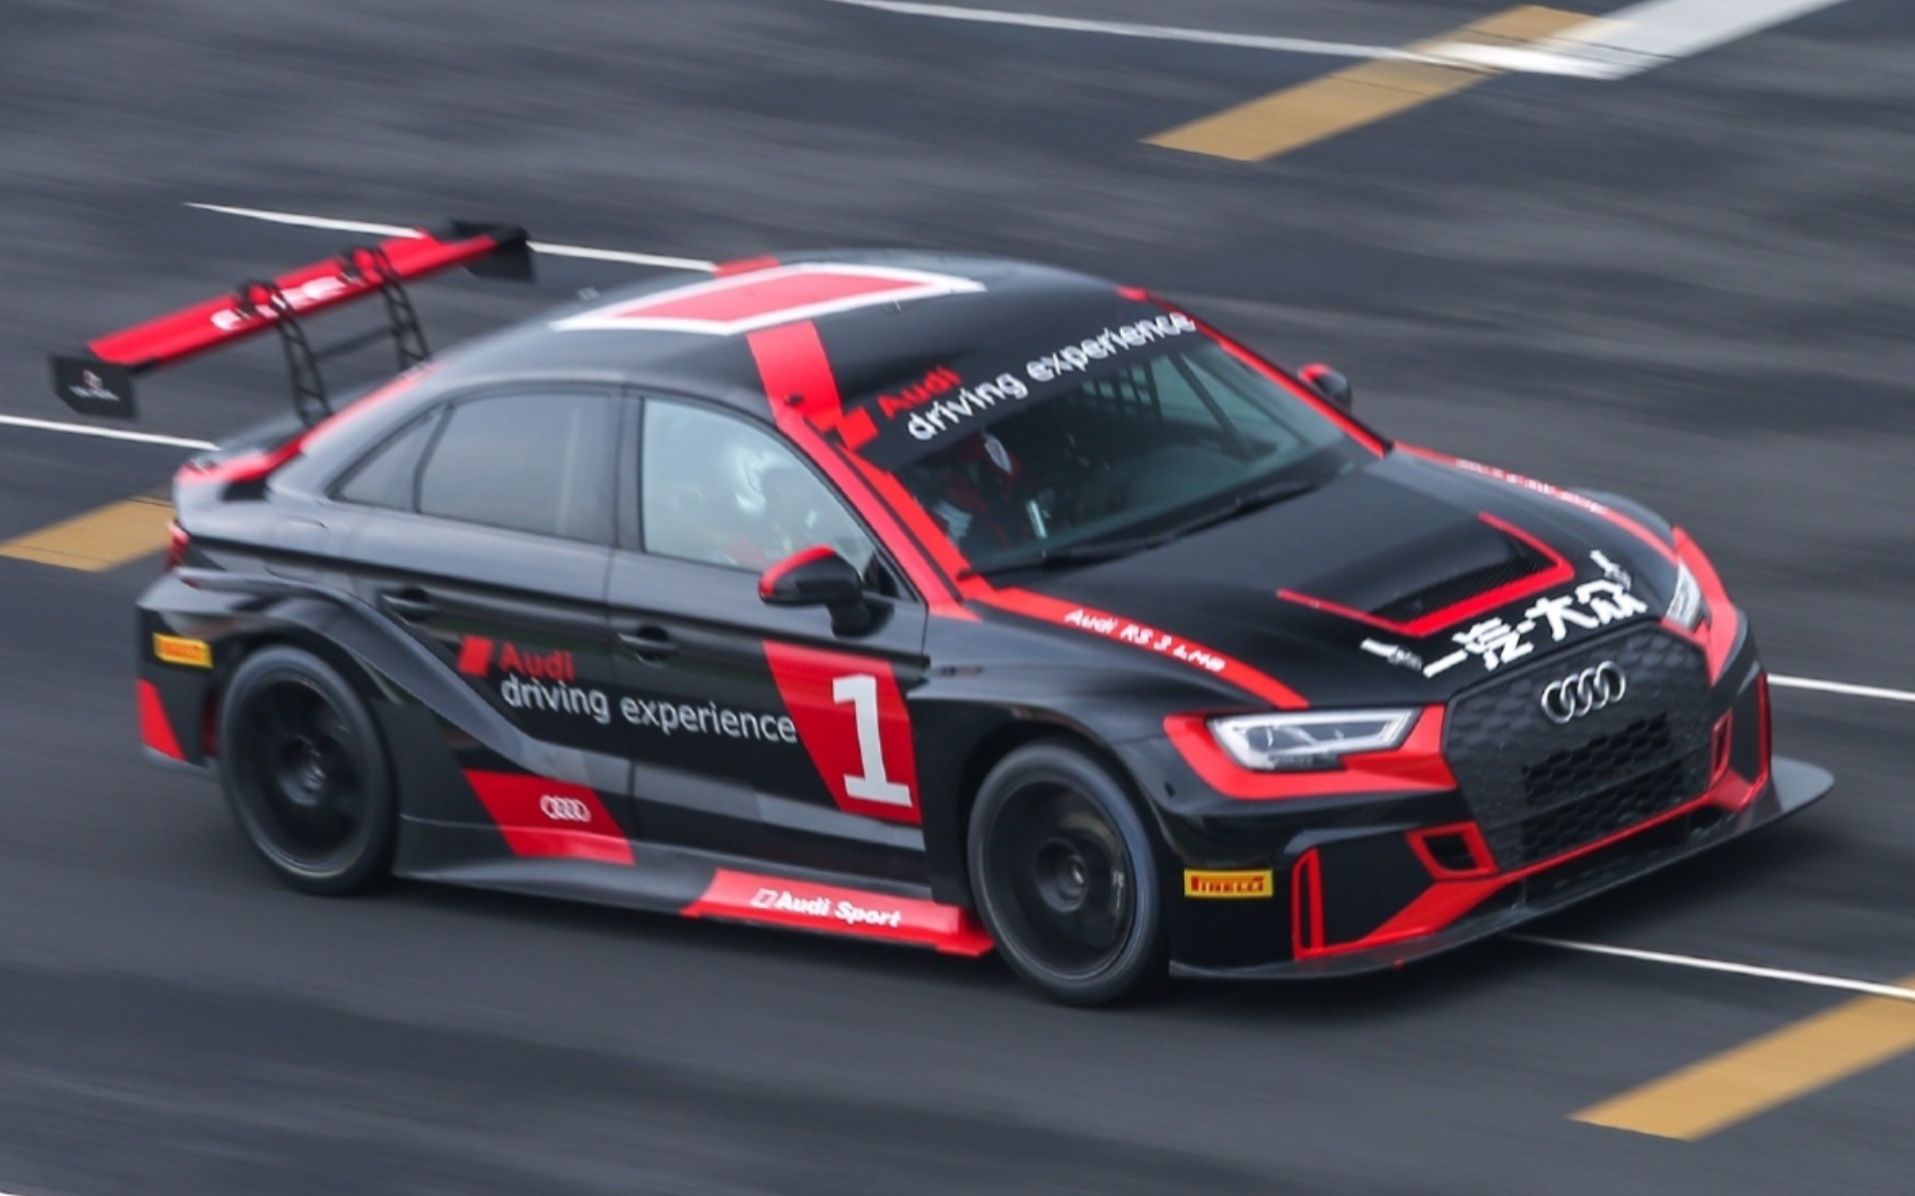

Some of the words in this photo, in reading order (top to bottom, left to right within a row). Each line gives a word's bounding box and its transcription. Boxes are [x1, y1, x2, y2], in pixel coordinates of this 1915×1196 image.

[877, 365, 963, 420] Audi
[908, 372, 1029, 441] driving
[1026, 312, 1197, 382] experience
[1064, 608, 1118, 635] Audi
[498, 642, 575, 682] Audi
[501, 674, 611, 725] driving
[619, 694, 798, 744] experience
[832, 674, 914, 808] 1
[776, 891, 832, 917] Audi
[833, 900, 902, 929] Sport
